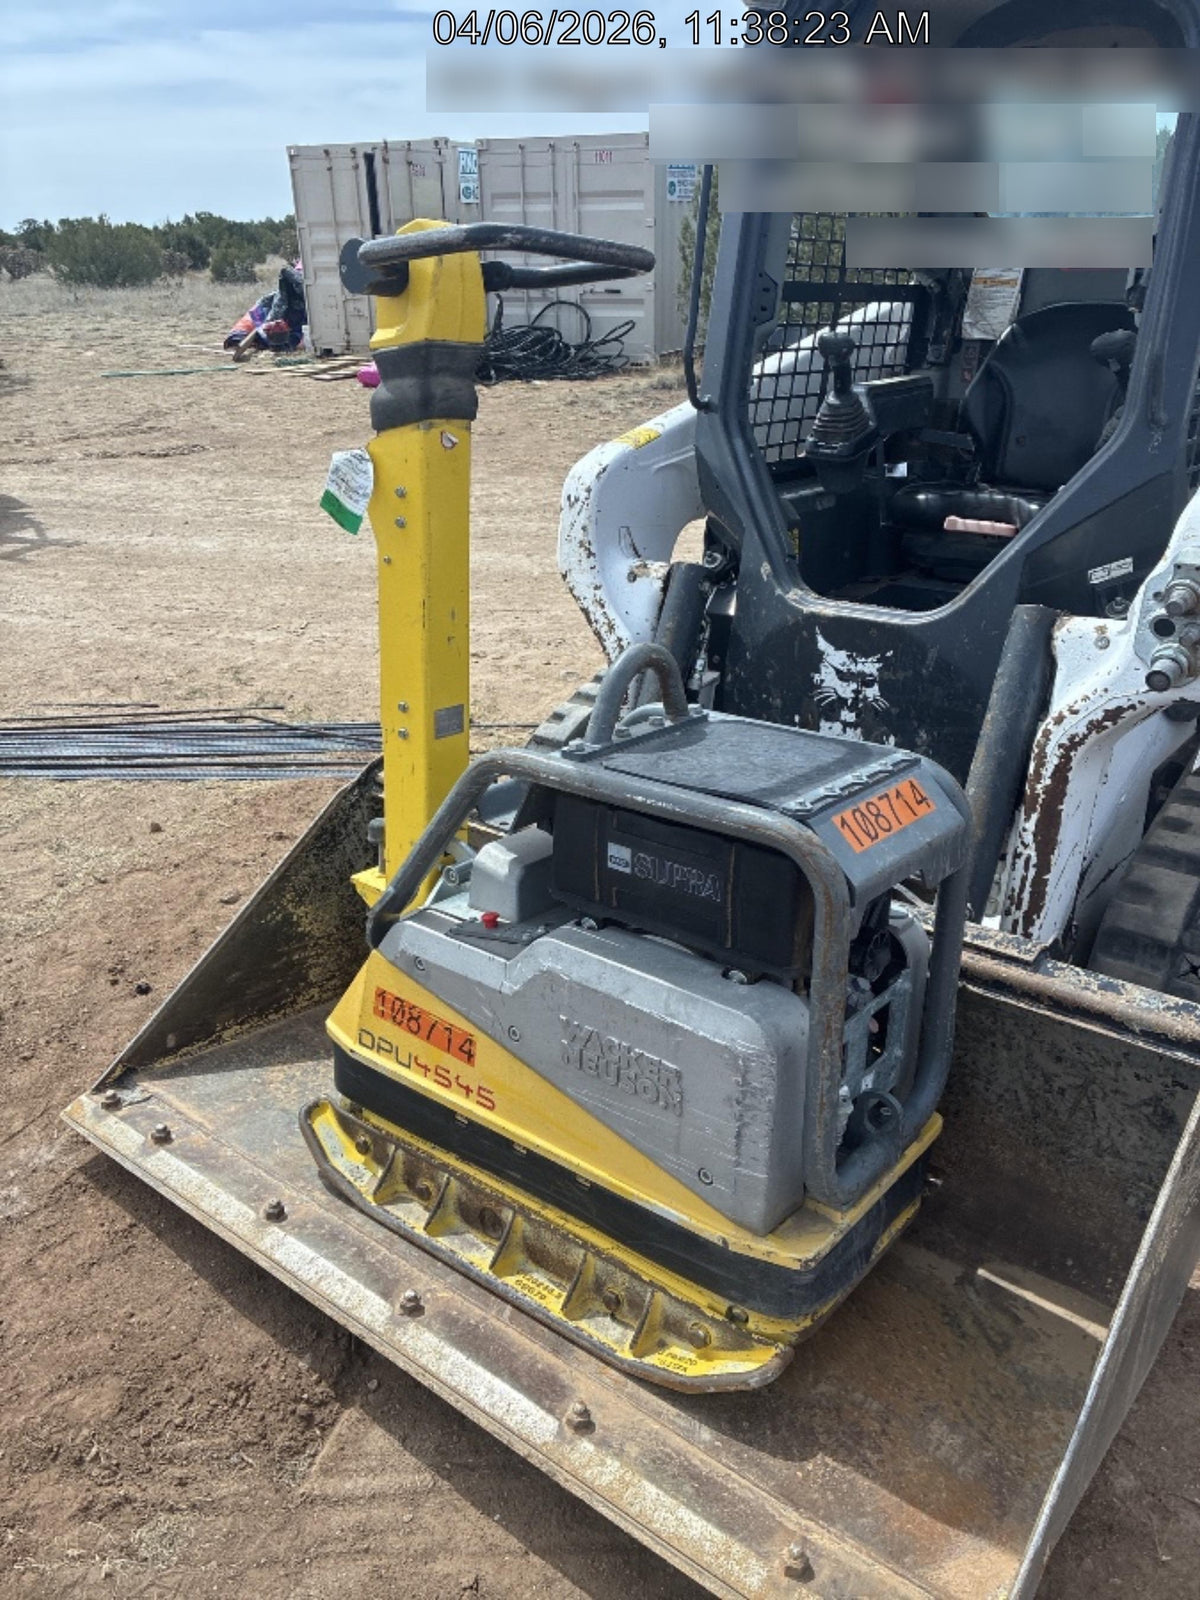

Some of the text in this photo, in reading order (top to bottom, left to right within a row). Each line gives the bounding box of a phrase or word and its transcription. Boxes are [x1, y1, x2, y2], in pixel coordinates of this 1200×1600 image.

[839, 782, 930, 848] 108714
[634, 852, 721, 902] SUPRA
[357, 1028, 497, 1112] DPU4545
